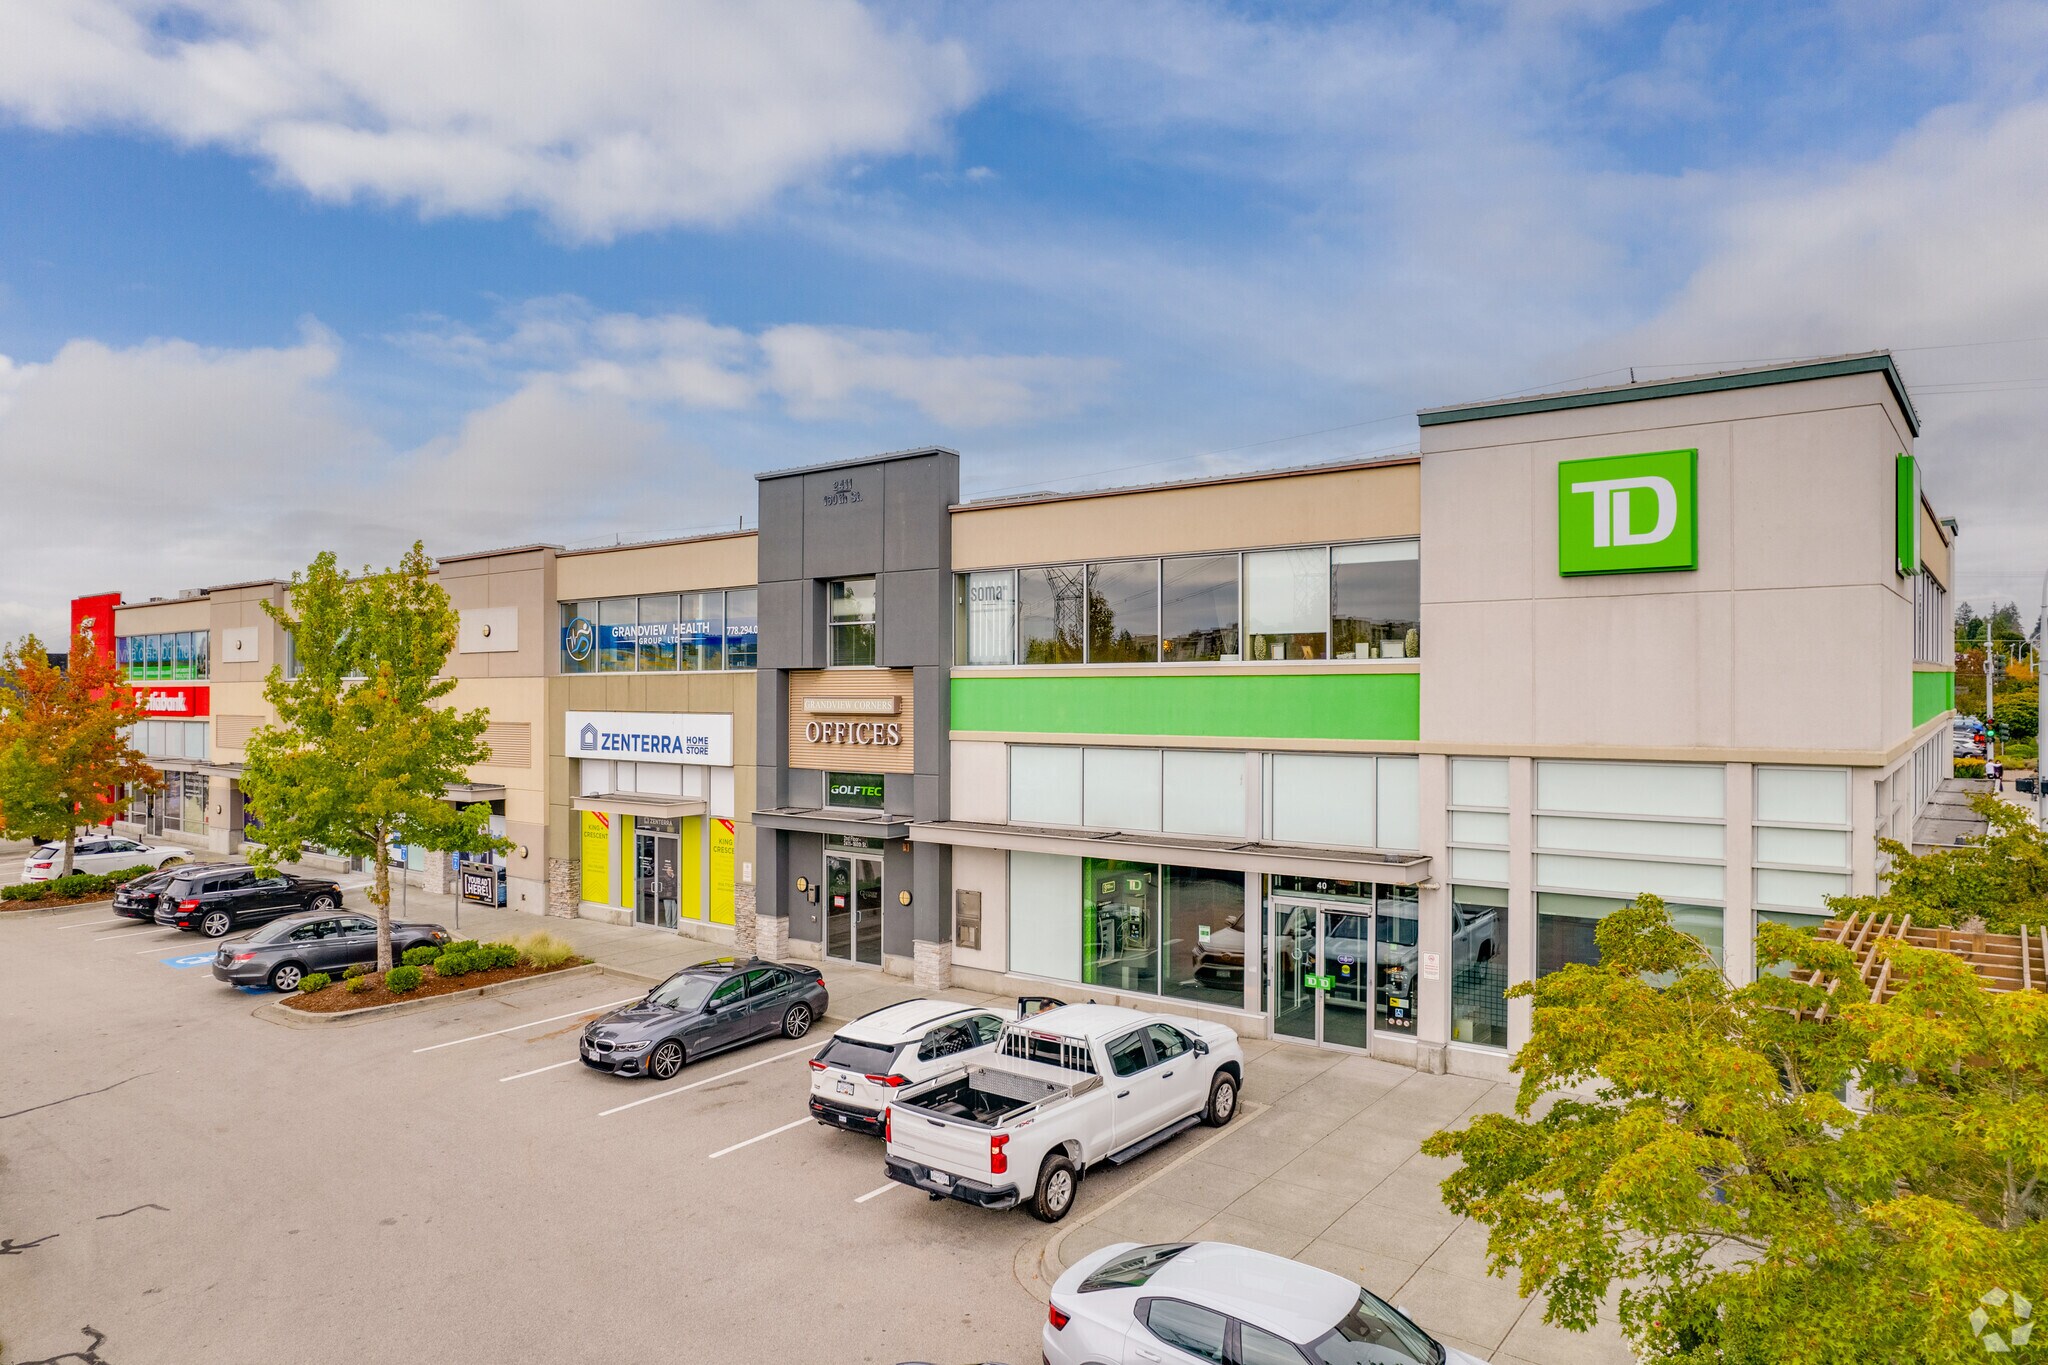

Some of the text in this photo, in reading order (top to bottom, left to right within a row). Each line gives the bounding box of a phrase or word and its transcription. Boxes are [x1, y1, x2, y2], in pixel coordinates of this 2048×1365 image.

[833, 478, 853, 490] 2411
[850, 491, 864, 504] St.
[1571, 476, 1677, 548] TD
[970, 585, 1003, 602] soma
[611, 624, 668, 638] GRANDVIEW
[672, 622, 710, 635] HEALTH
[638, 637, 663, 645] GROUP
[804, 700, 893, 710] GRANDVIEW CORNERS
[805, 721, 901, 746] OFFICES
[601, 733, 683, 754] ZENTERRA
[686, 736, 709, 745] HOME
[686, 746, 709, 755] STORE
[831, 785, 882, 796] GOLFTEC
[650, 818, 673, 826] ZENTERRA
[584, 831, 608, 839] CRESCENT
[718, 838, 733, 846] KING
[468, 883, 488, 896] HERE!
[1126, 879, 1142, 890] TD
[1316, 881, 1327, 890] 40
